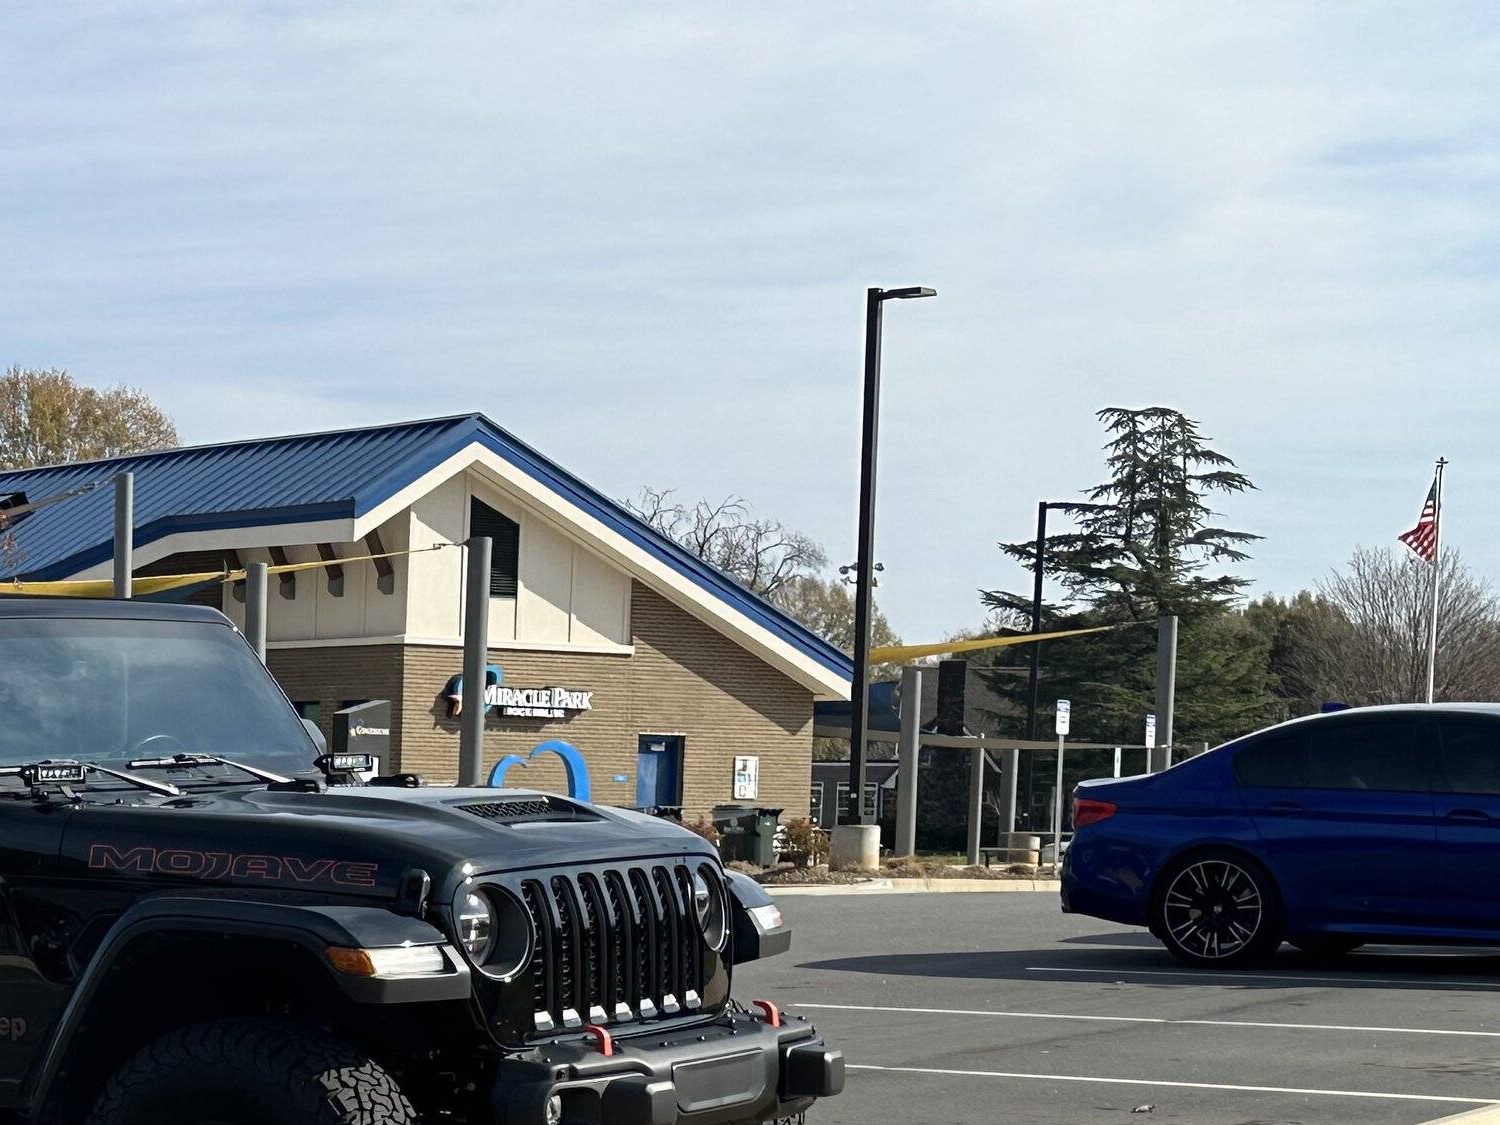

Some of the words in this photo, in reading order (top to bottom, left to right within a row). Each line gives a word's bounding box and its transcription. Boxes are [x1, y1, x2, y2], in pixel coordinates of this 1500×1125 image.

[484, 684, 550, 708] MIRACLE
[553, 687, 593, 710] PARK
[88, 845, 378, 887] MOJAVE
